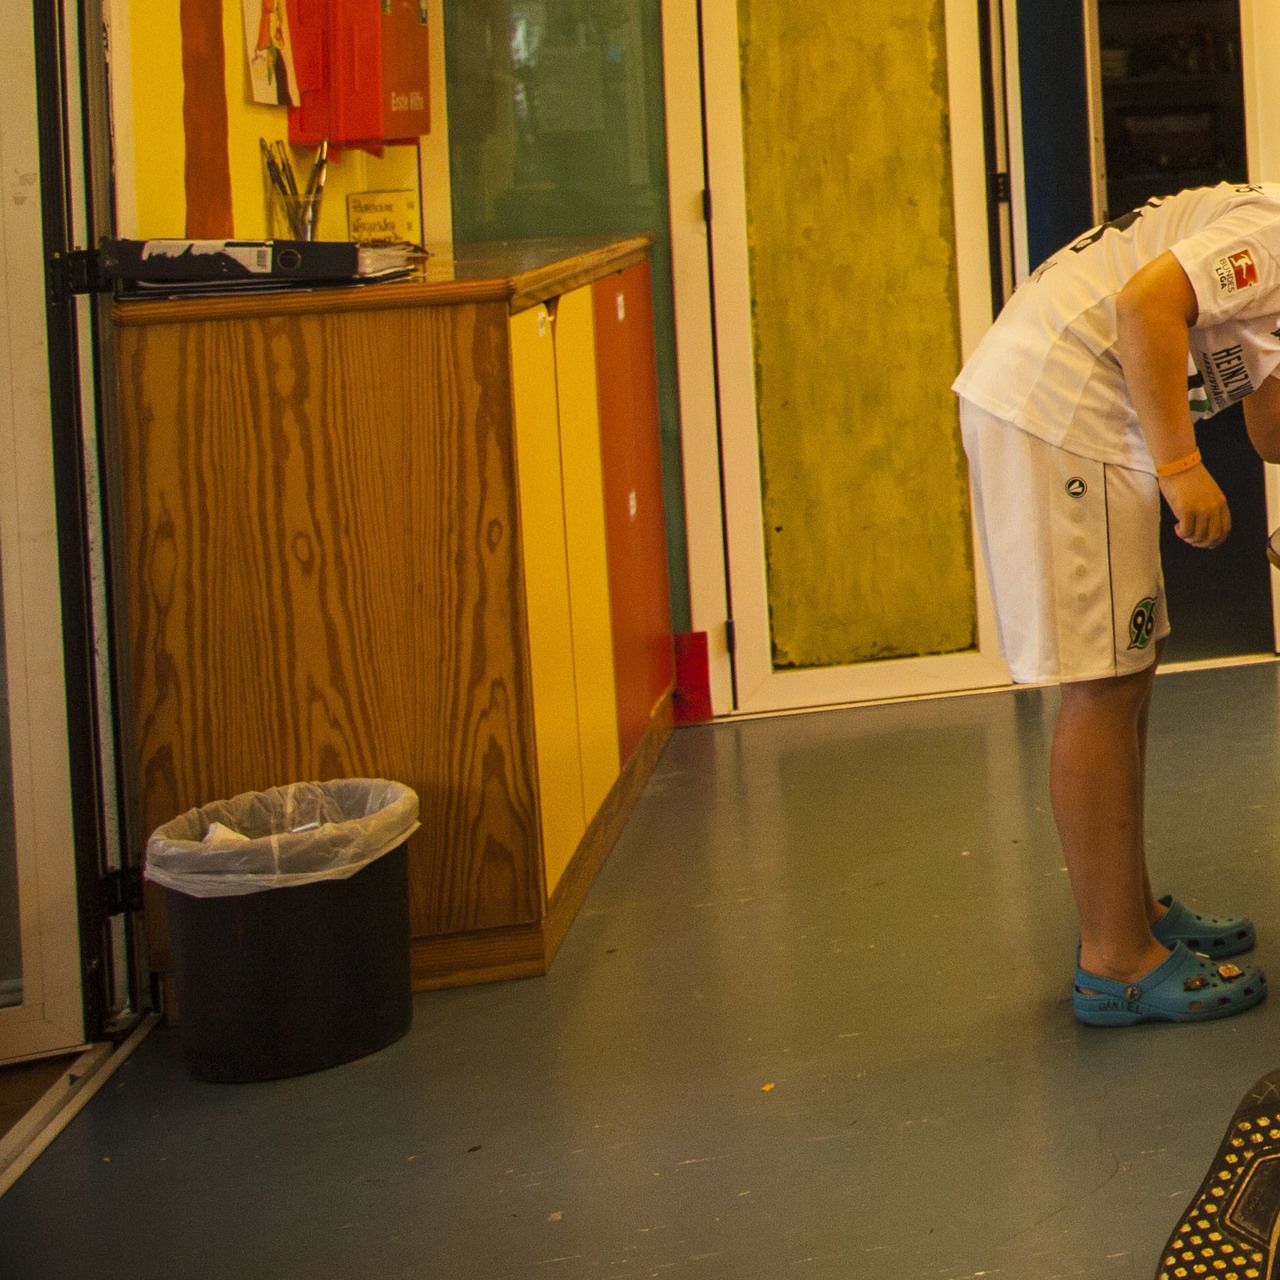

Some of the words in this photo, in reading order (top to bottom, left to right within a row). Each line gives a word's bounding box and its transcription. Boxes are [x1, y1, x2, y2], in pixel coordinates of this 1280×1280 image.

[1215, 267, 1228, 290] LIGA
[1219, 258, 1236, 293] BUNDES
[1212, 344, 1250, 388] HEINZ
[1132, 600, 1156, 644] 96
[1098, 1000, 1145, 1015] DANIEL
